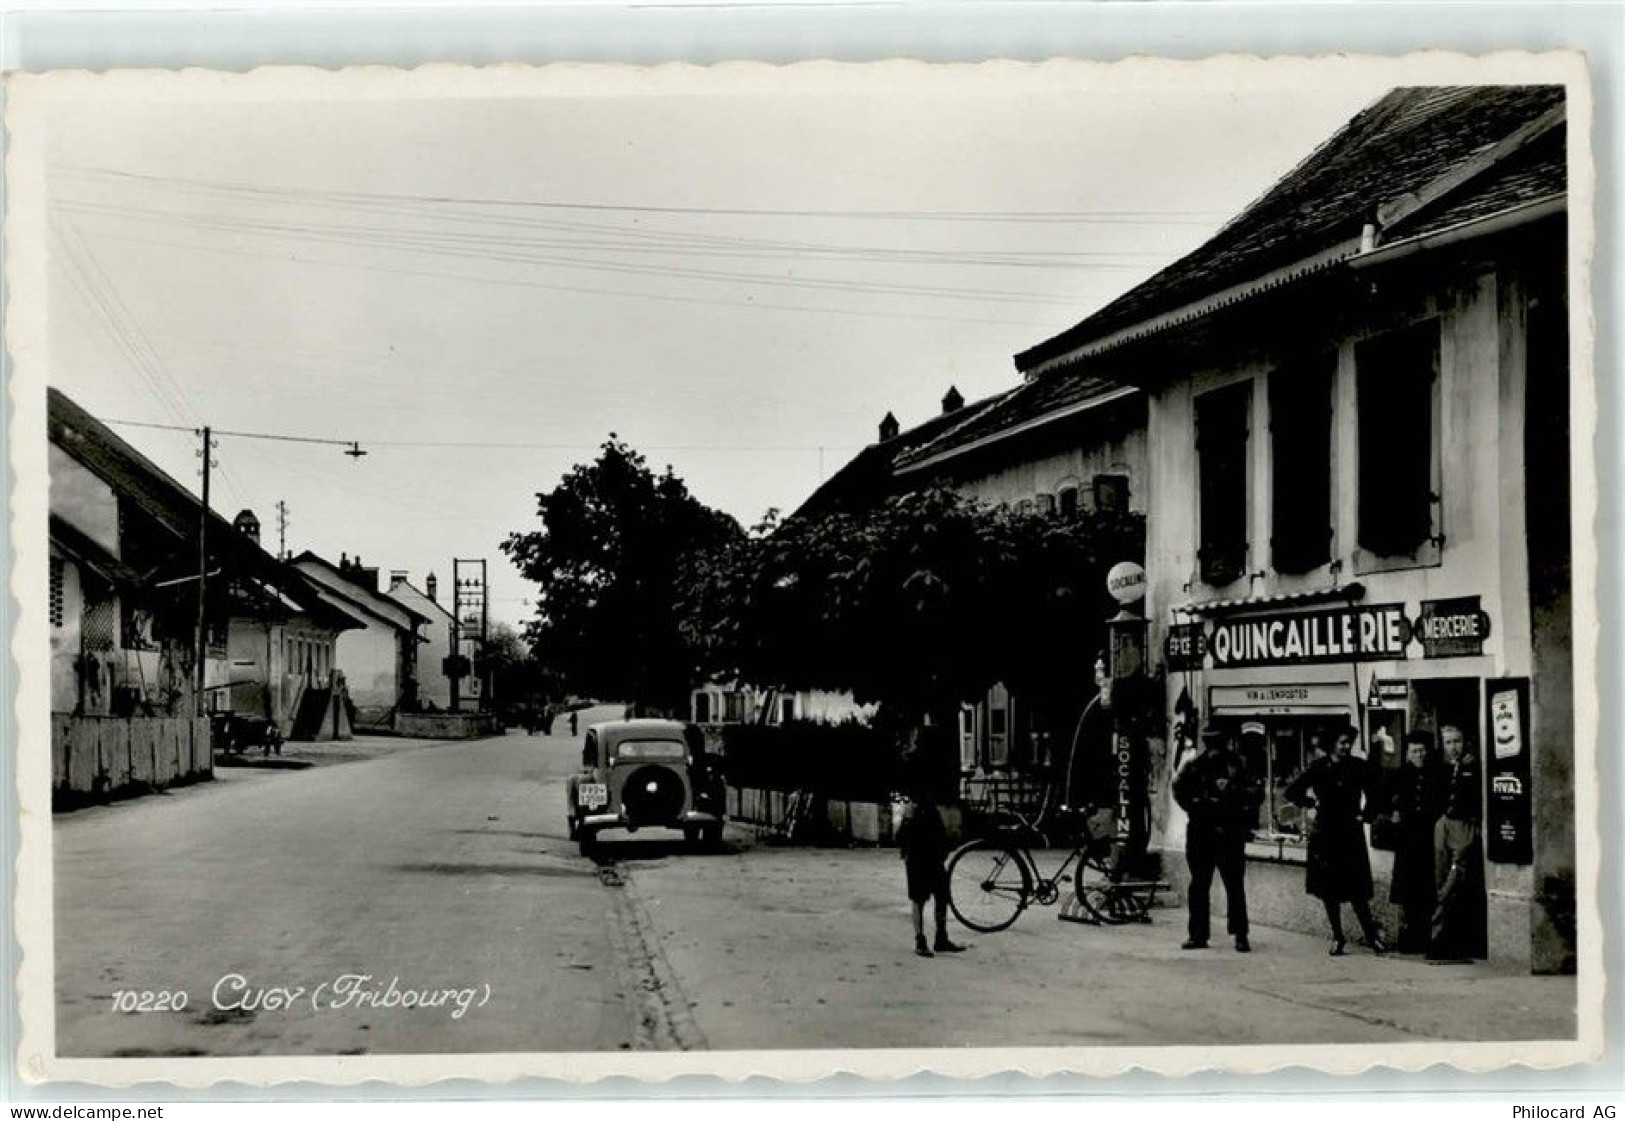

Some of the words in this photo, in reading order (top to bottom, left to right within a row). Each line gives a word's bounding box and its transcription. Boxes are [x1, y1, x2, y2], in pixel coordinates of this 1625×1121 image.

[1214, 610, 1401, 664] QUINCAILLERIE
[1424, 613, 1479, 639] MERCERIE
[1117, 735, 1131, 846] SOCALINE
